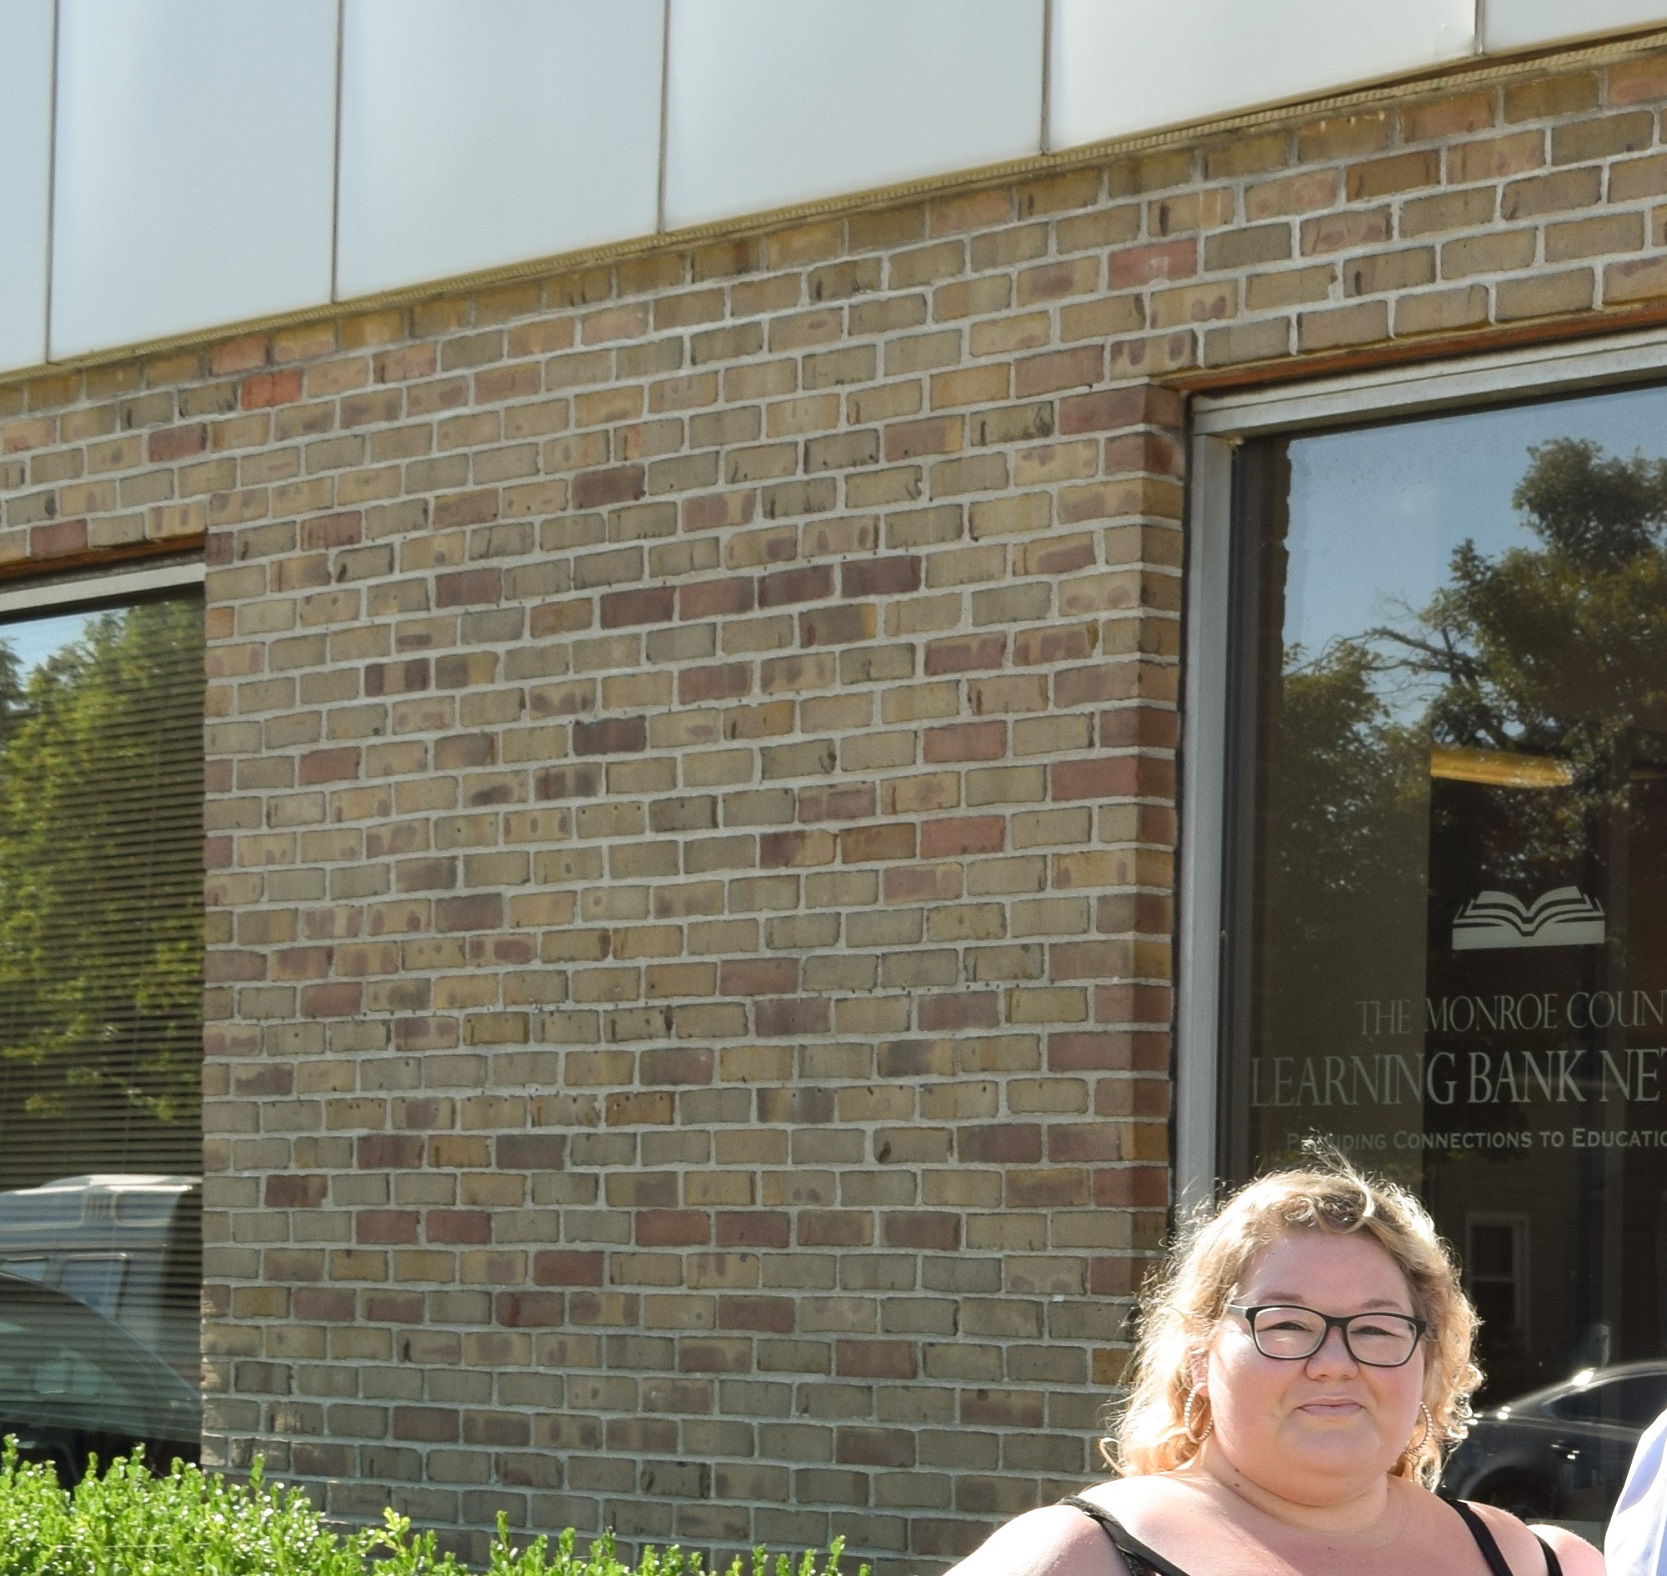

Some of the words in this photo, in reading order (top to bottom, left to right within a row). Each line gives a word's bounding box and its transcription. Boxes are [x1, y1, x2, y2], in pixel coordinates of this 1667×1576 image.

[1354, 1000, 1411, 1035] THE
[1422, 992, 1558, 1033] MONROE
[1250, 1051, 1458, 1107] LEARNING
[1467, 1050, 1587, 1104] BANK
[1287, 1131, 1387, 1150] PIDING
